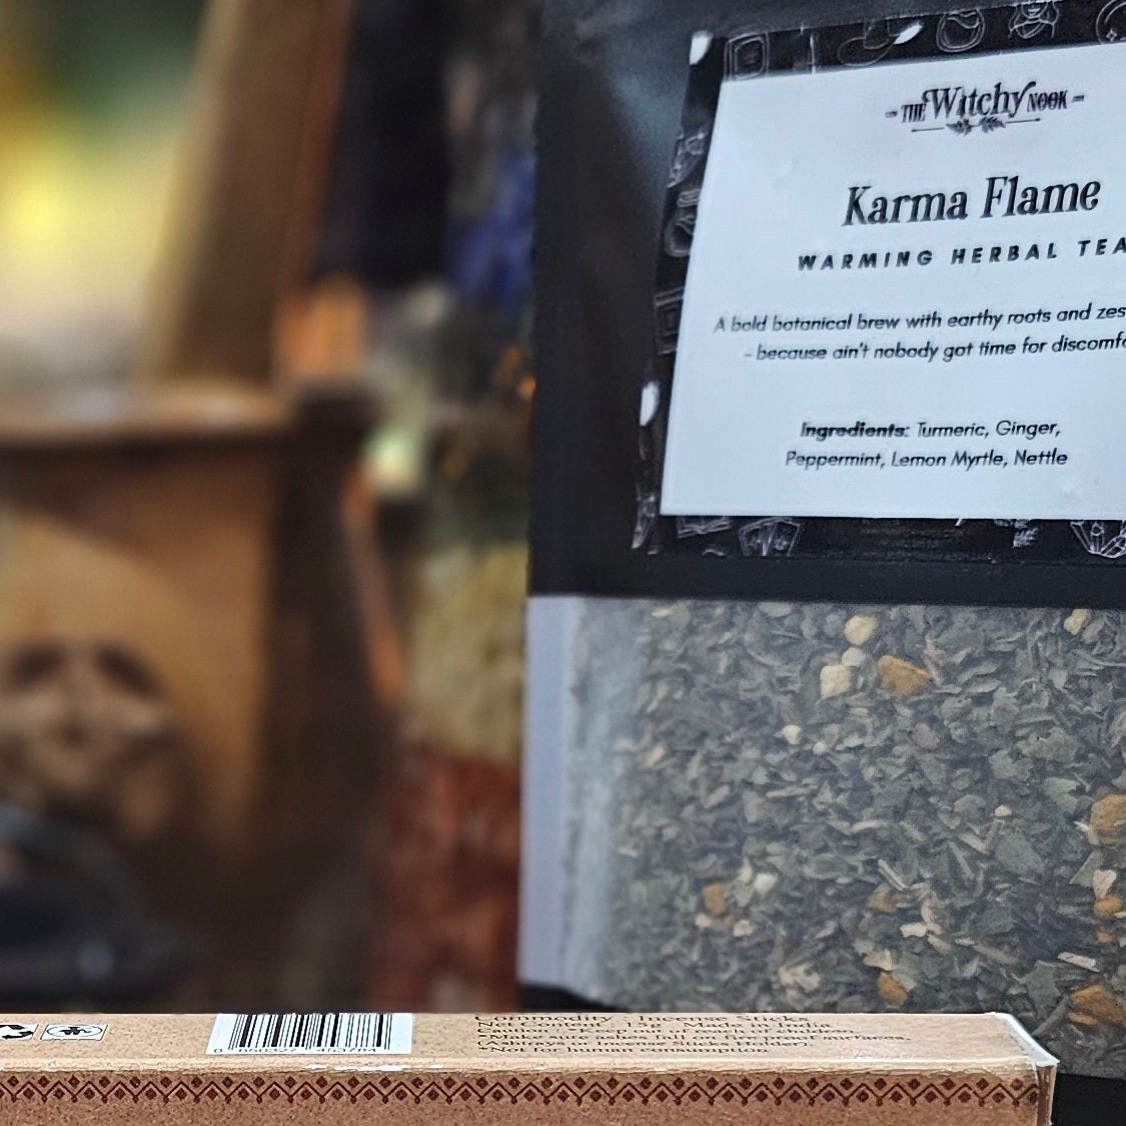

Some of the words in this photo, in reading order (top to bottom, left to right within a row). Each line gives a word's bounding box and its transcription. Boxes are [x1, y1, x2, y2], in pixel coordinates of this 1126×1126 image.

[901, 102, 927, 123] THE
[922, 80, 1037, 118] Witchy
[1026, 89, 1068, 112] NOOK
[841, 184, 969, 227] Karma
[980, 175, 1102, 219] Flame
[798, 249, 933, 271] WARMING
[951, 243, 1058, 265] HERBAL
[1077, 236, 1126, 257] TEA
[713, 316, 726, 332] A
[730, 314, 768, 332] bold
[771, 312, 853, 332] botanical
[856, 312, 901, 330] brew
[905, 310, 942, 328] with
[947, 308, 1003, 331] earthy
[1007, 308, 1052, 325] roots
[1056, 302, 1092, 322] and
[756, 343, 828, 360] because
[832, 341, 871, 360] ain't
[873, 341, 940, 363] nobody
[942, 342, 974, 363] got
[979, 340, 1016, 356] time
[1022, 336, 1048, 354] for
[800, 420, 910, 441] Ingredients:
[916, 421, 989, 439] Turmeric,
[995, 420, 1061, 440] Ginger,
[785, 450, 885, 471] Peppermint,
[891, 450, 947, 468] Lemon
[951, 449, 1008, 471] Myrtle,
[1013, 448, 1068, 466] Nettle
[475, 1015, 614, 1023] Commodity
